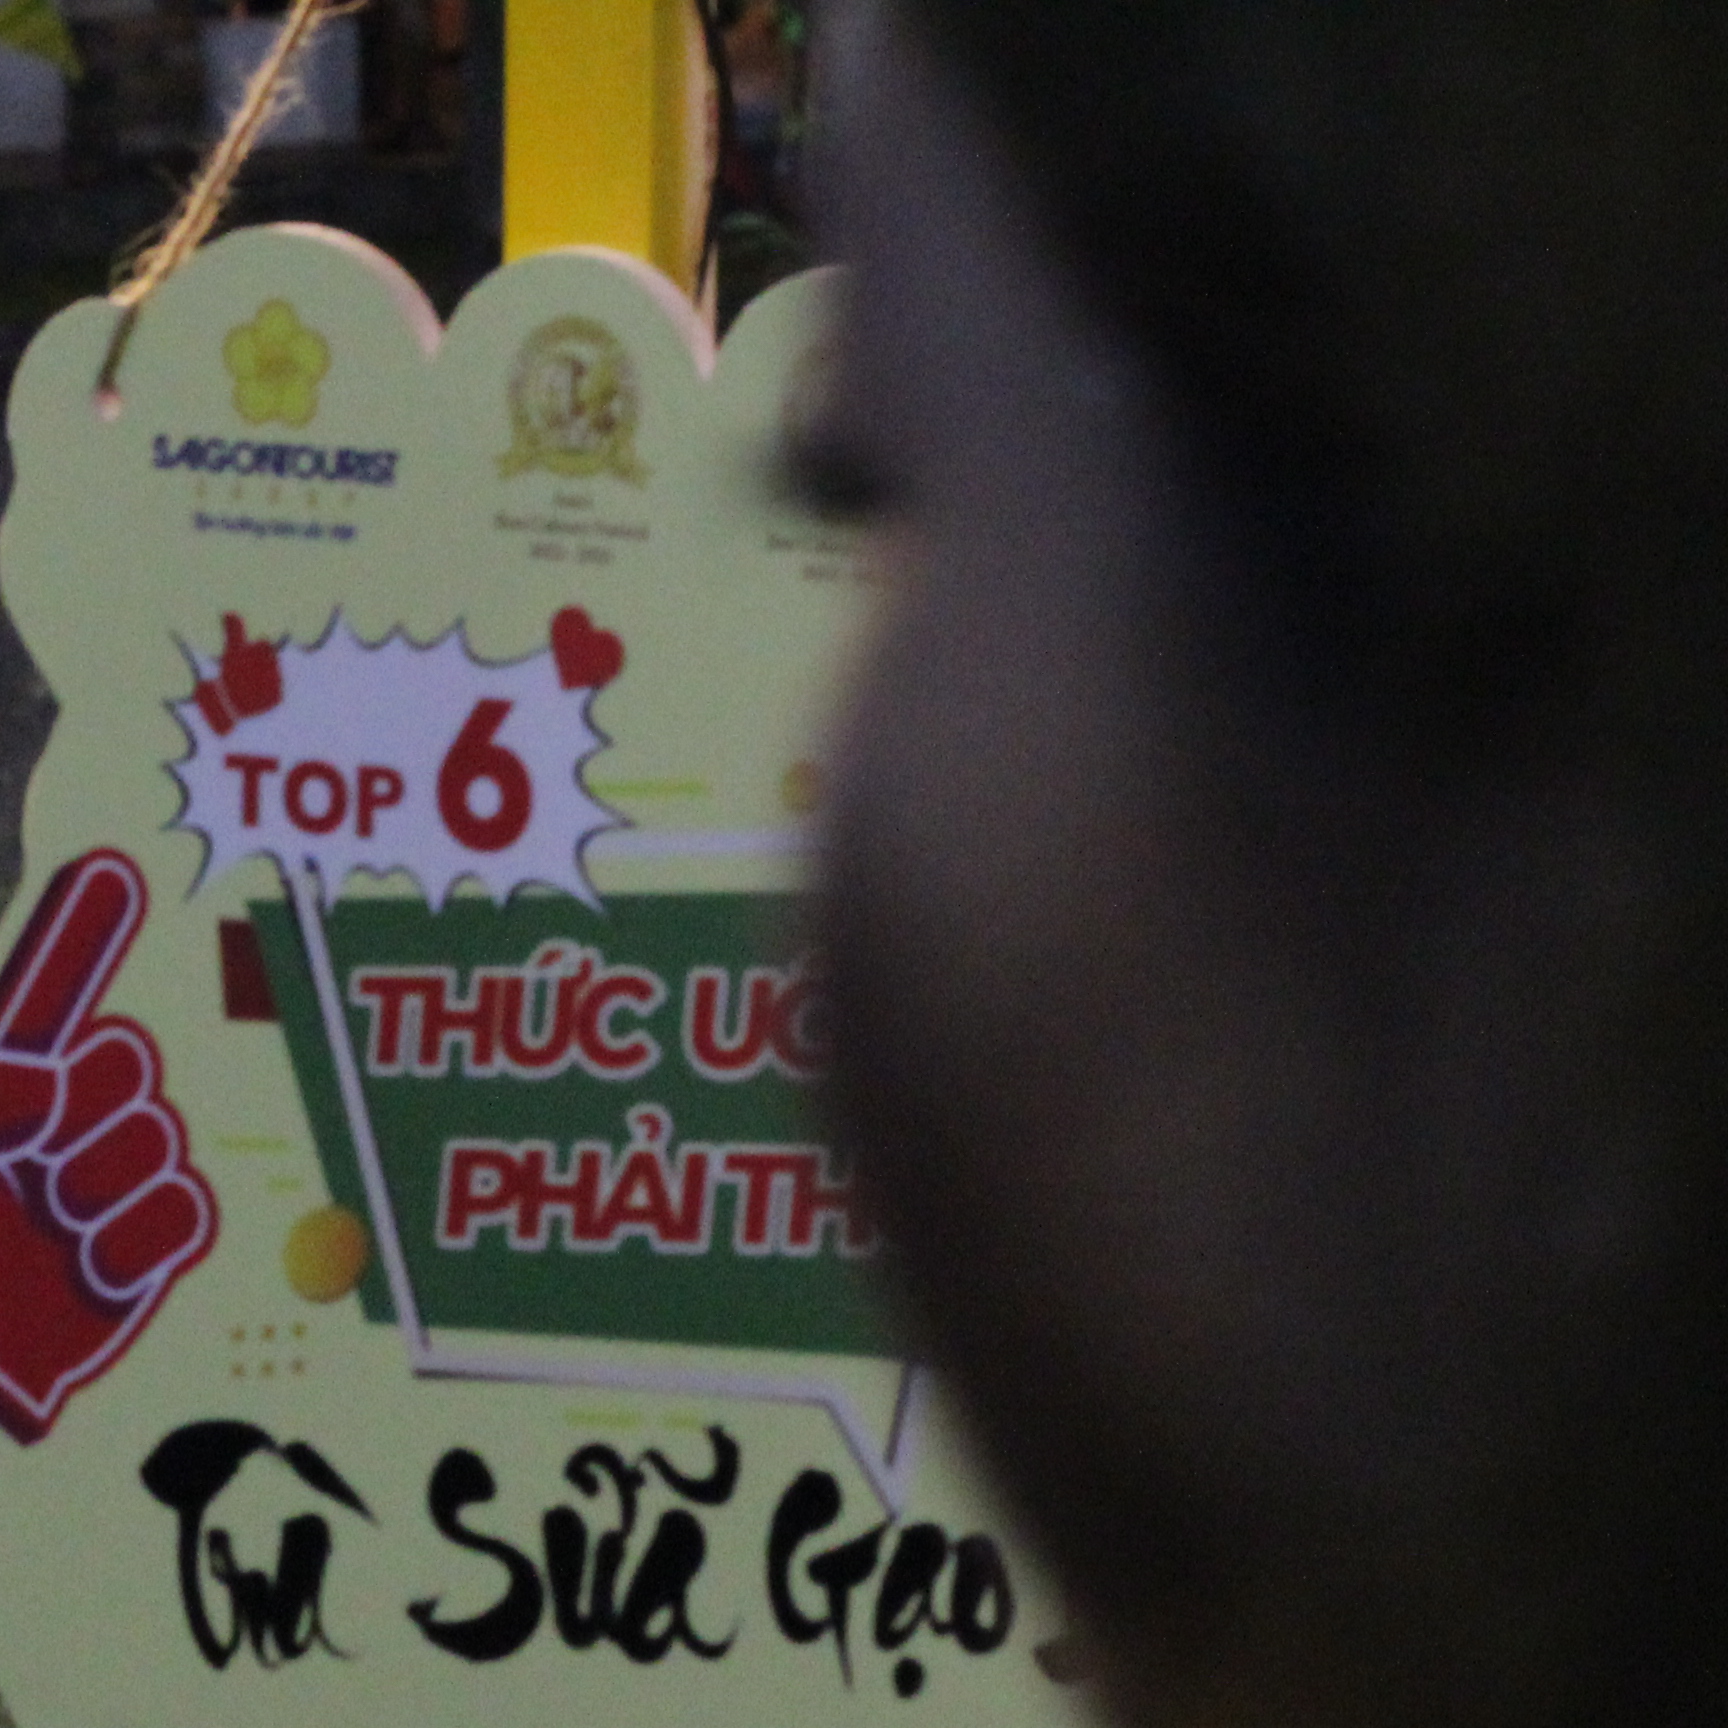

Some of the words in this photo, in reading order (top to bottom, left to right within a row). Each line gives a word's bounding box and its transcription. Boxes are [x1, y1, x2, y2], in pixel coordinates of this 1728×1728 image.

[223, 752, 406, 838] TOP
[436, 698, 534, 853] 6
[354, 942, 662, 1074] THỨC
[441, 1110, 710, 1248] PHẢI
[406, 1422, 738, 1663] Sữa
